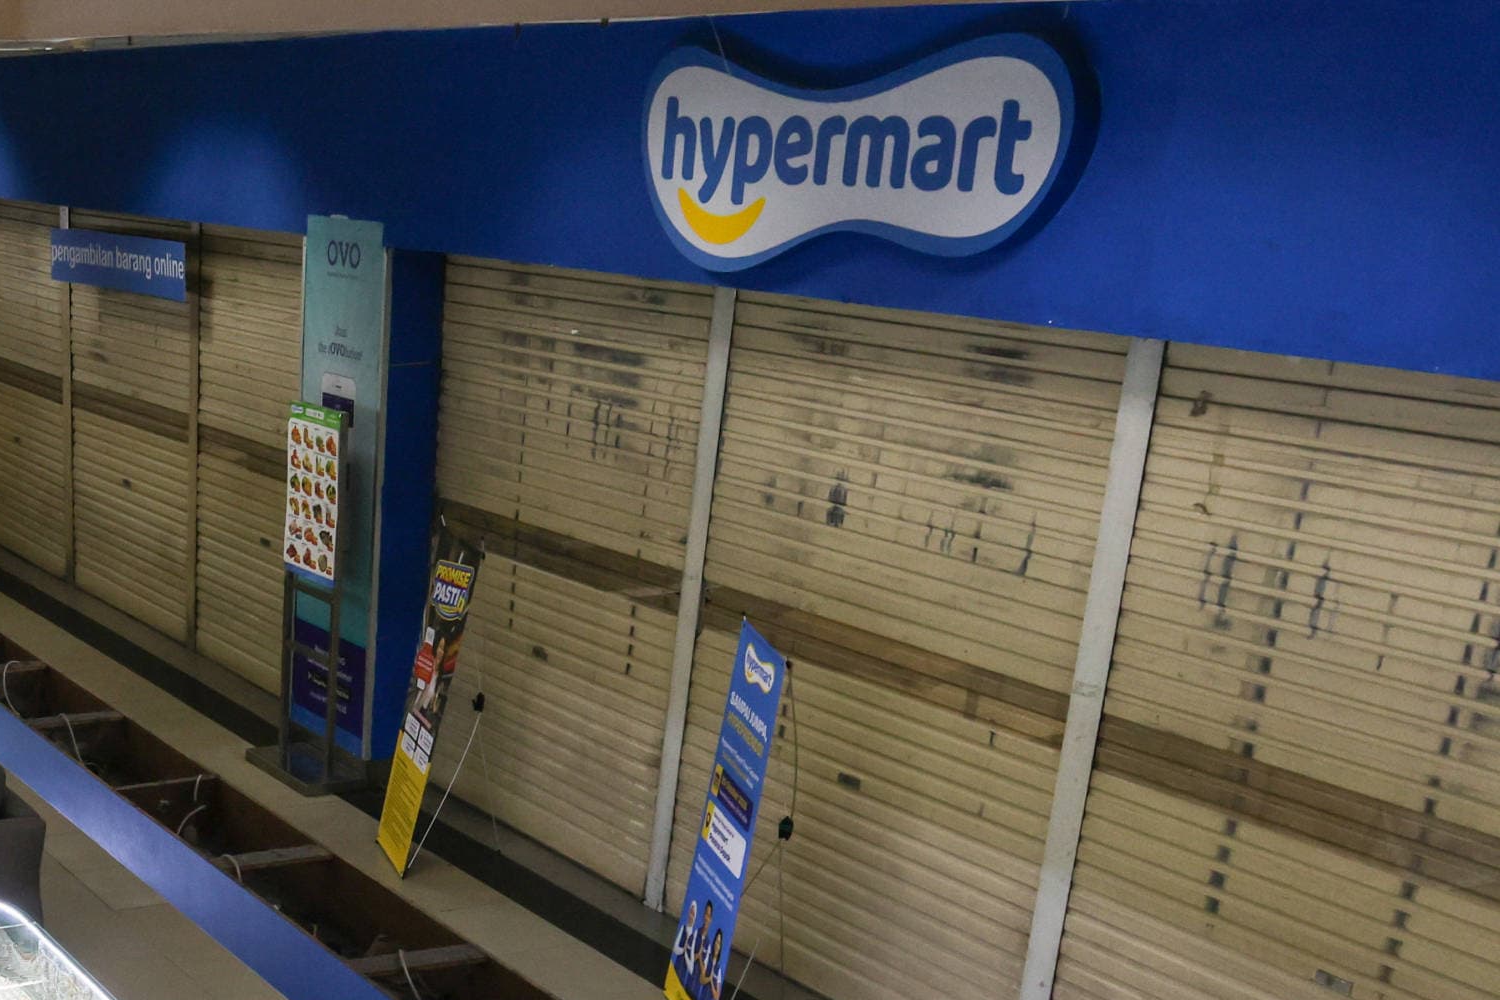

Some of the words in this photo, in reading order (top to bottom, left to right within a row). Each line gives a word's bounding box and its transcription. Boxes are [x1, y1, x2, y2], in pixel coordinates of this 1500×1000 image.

[662, 96, 1032, 206] hypermart
[51, 242, 114, 269] pengambilan
[115, 245, 152, 280] barang
[154, 252, 185, 280] online
[327, 239, 361, 269] OVO
[435, 565, 472, 589] PROMISE
[433, 582, 461, 606] PASTI
